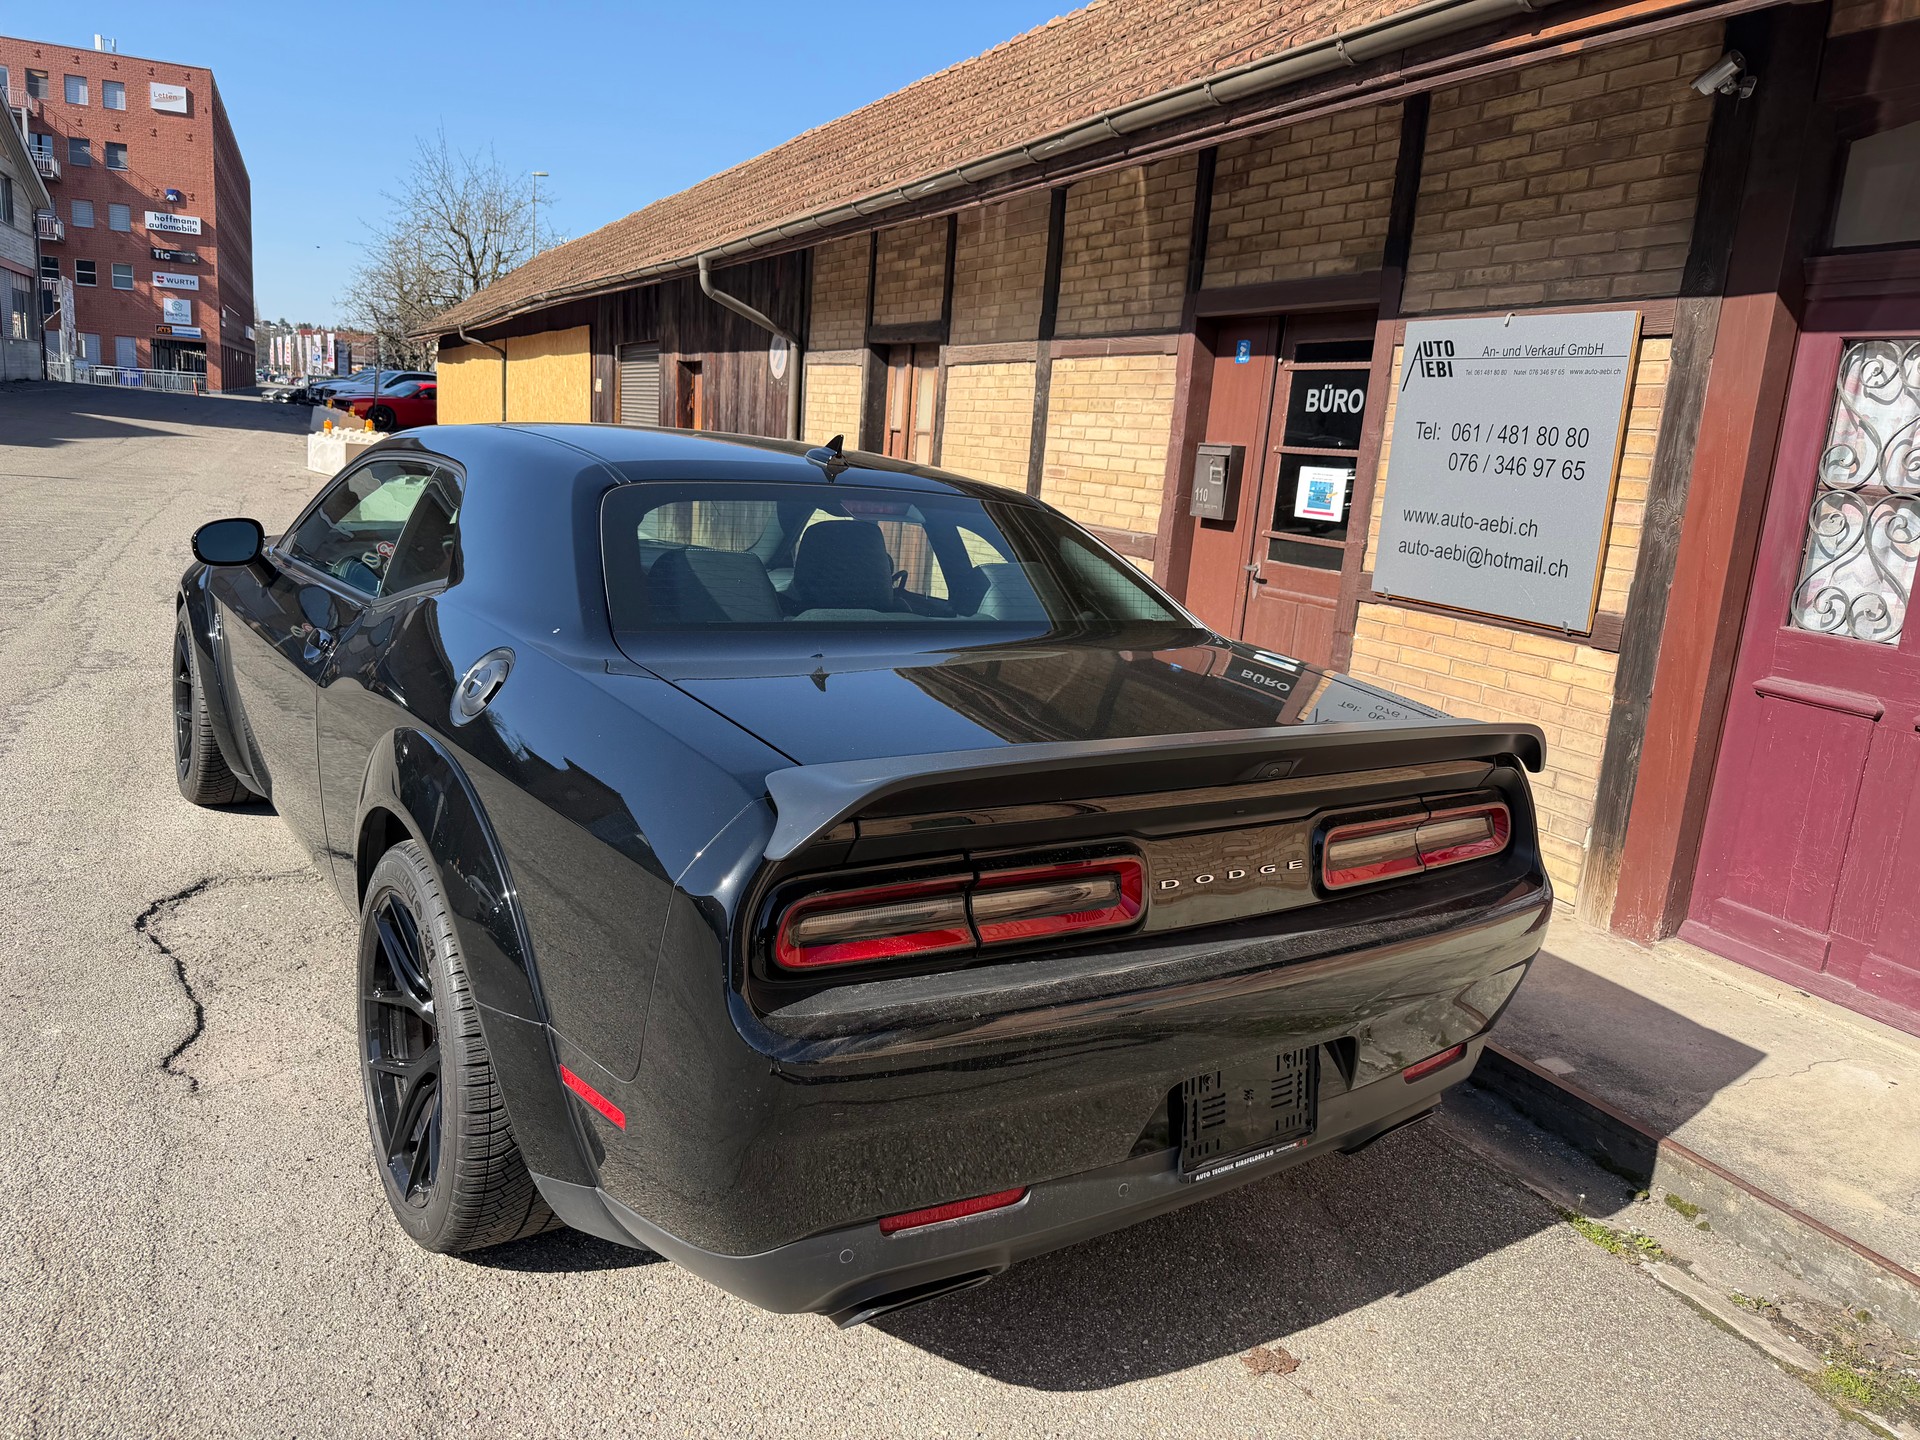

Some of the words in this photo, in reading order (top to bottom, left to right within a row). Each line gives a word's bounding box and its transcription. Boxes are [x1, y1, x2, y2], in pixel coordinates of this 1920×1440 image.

[153, 91, 178, 101] Letten
[148, 222, 198, 233] automobile
[154, 213, 198, 226] hoffmann
[153, 249, 171, 260] Tic
[1482, 345, 1500, 357] An-
[1502, 345, 1522, 357] und
[1524, 343, 1566, 356] Verkauf
[1567, 343, 1605, 356] GmbH
[1569, 368, 1622, 376] www.auto-aebi.ch
[1305, 384, 1365, 414] BÜRO
[1416, 421, 1442, 441] Tel:
[1451, 422, 1481, 442] 061
[1486, 424, 1494, 443] /
[1497, 424, 1529, 445] 481
[1536, 426, 1560, 447] 80
[1565, 427, 1590, 448] 80
[1448, 452, 1479, 473] 076
[1482, 454, 1491, 474] /
[1494, 455, 1527, 476] 346
[1533, 457, 1557, 478] 97
[1561, 459, 1586, 481] 65
[1195, 487, 1208, 502] 110
[1403, 509, 1539, 538] www.auto-aebi.ch
[1398, 539, 1569, 578] auto-aebi@hotmail.ch
[1160, 859, 1303, 890] DODGE
[1195, 1171, 1211, 1182] AUTO
[1211, 1163, 1235, 1176] TECHNIK
[1235, 1152, 1265, 1168] BIRSFELDEN
[1266, 1149, 1274, 1158] AG
